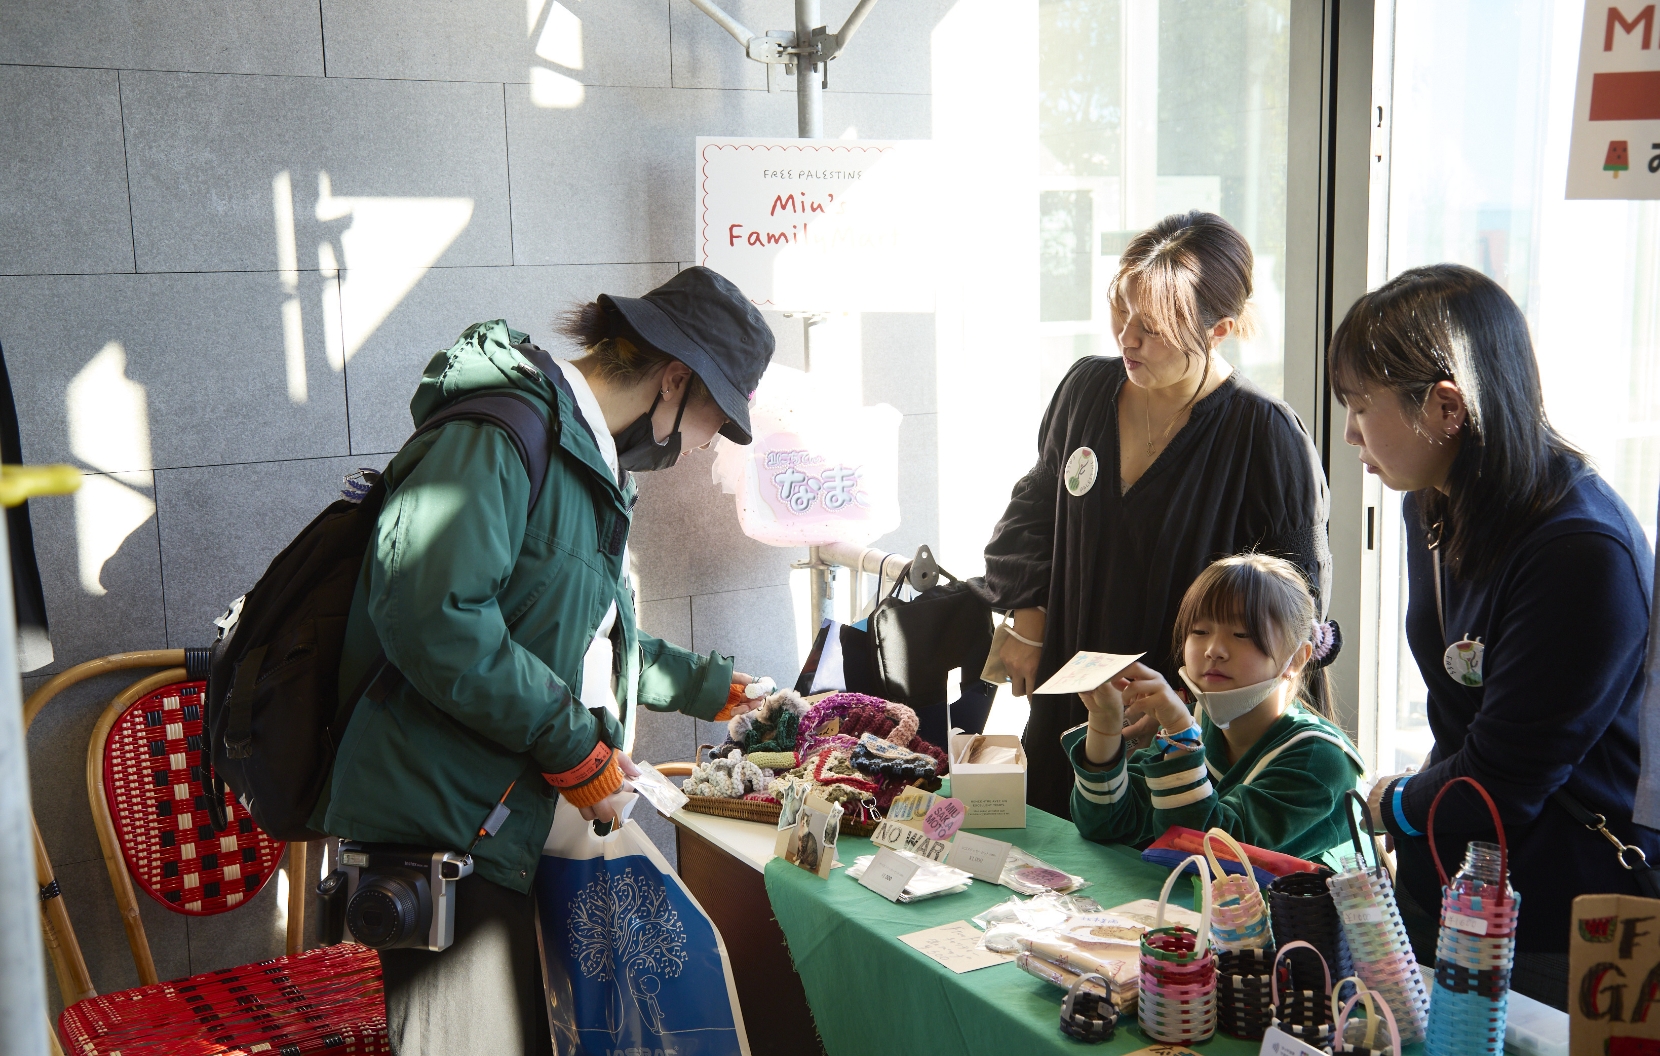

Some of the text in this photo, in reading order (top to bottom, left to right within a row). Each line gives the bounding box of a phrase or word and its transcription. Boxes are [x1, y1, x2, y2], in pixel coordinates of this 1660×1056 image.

[1603, 4, 1660, 52] M
[763, 169, 863, 180] FREE PALESTINE
[770, 191, 846, 217] Miu's
[934, 807, 954, 831] SAKA
[943, 802, 960, 819] MIU
[925, 813, 947, 839] MOTO
[876, 822, 903, 843] NO
[904, 830, 946, 862] WAR
[1619, 915, 1660, 961] F
